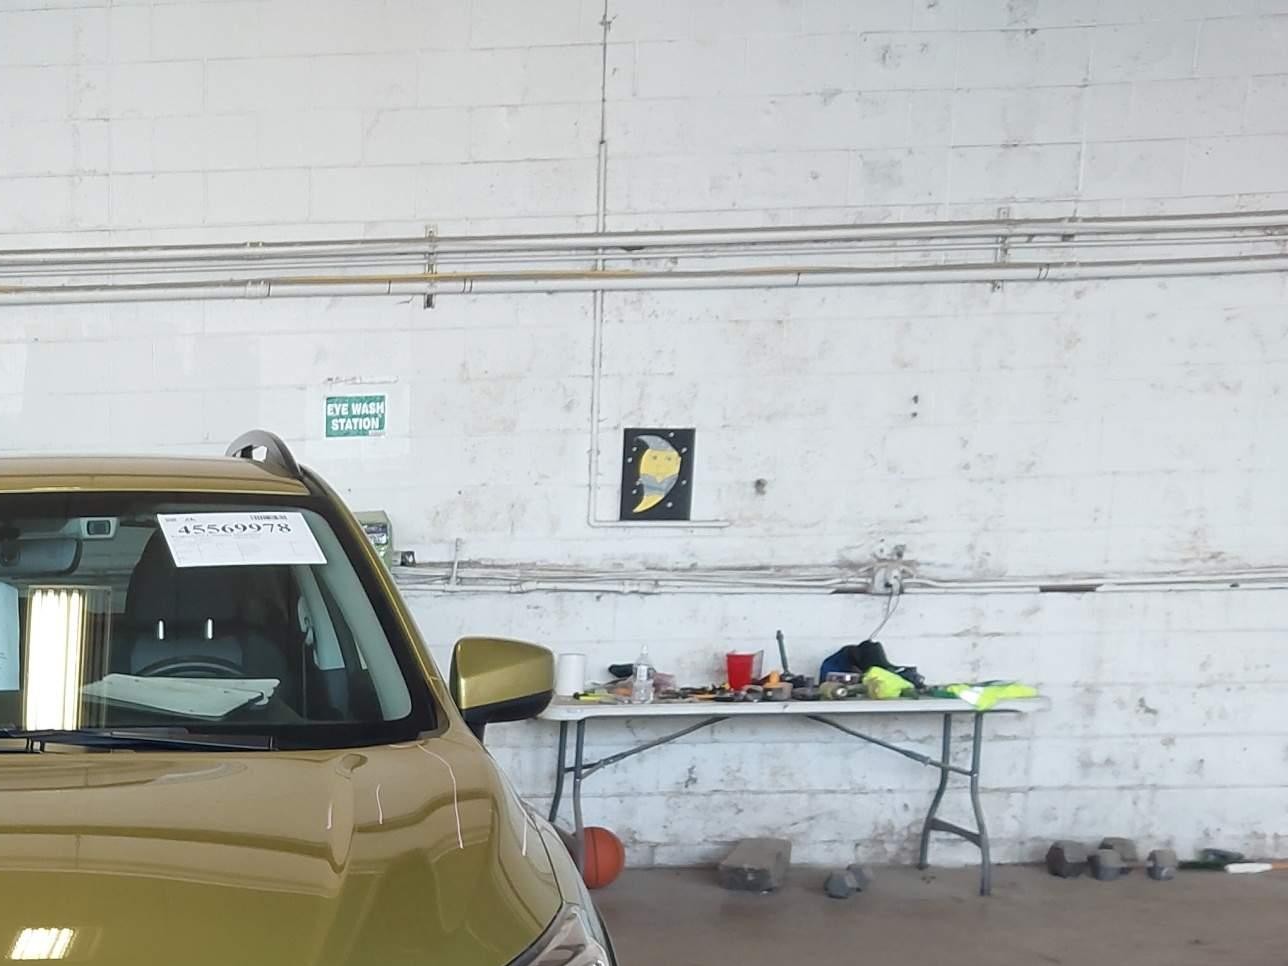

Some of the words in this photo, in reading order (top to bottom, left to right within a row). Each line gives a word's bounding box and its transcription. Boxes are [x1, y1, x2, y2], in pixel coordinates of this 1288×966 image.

[327, 403, 349, 416] EYE
[351, 401, 385, 415] WASH
[331, 417, 380, 431] STATION
[178, 522, 292, 535] 45569978
